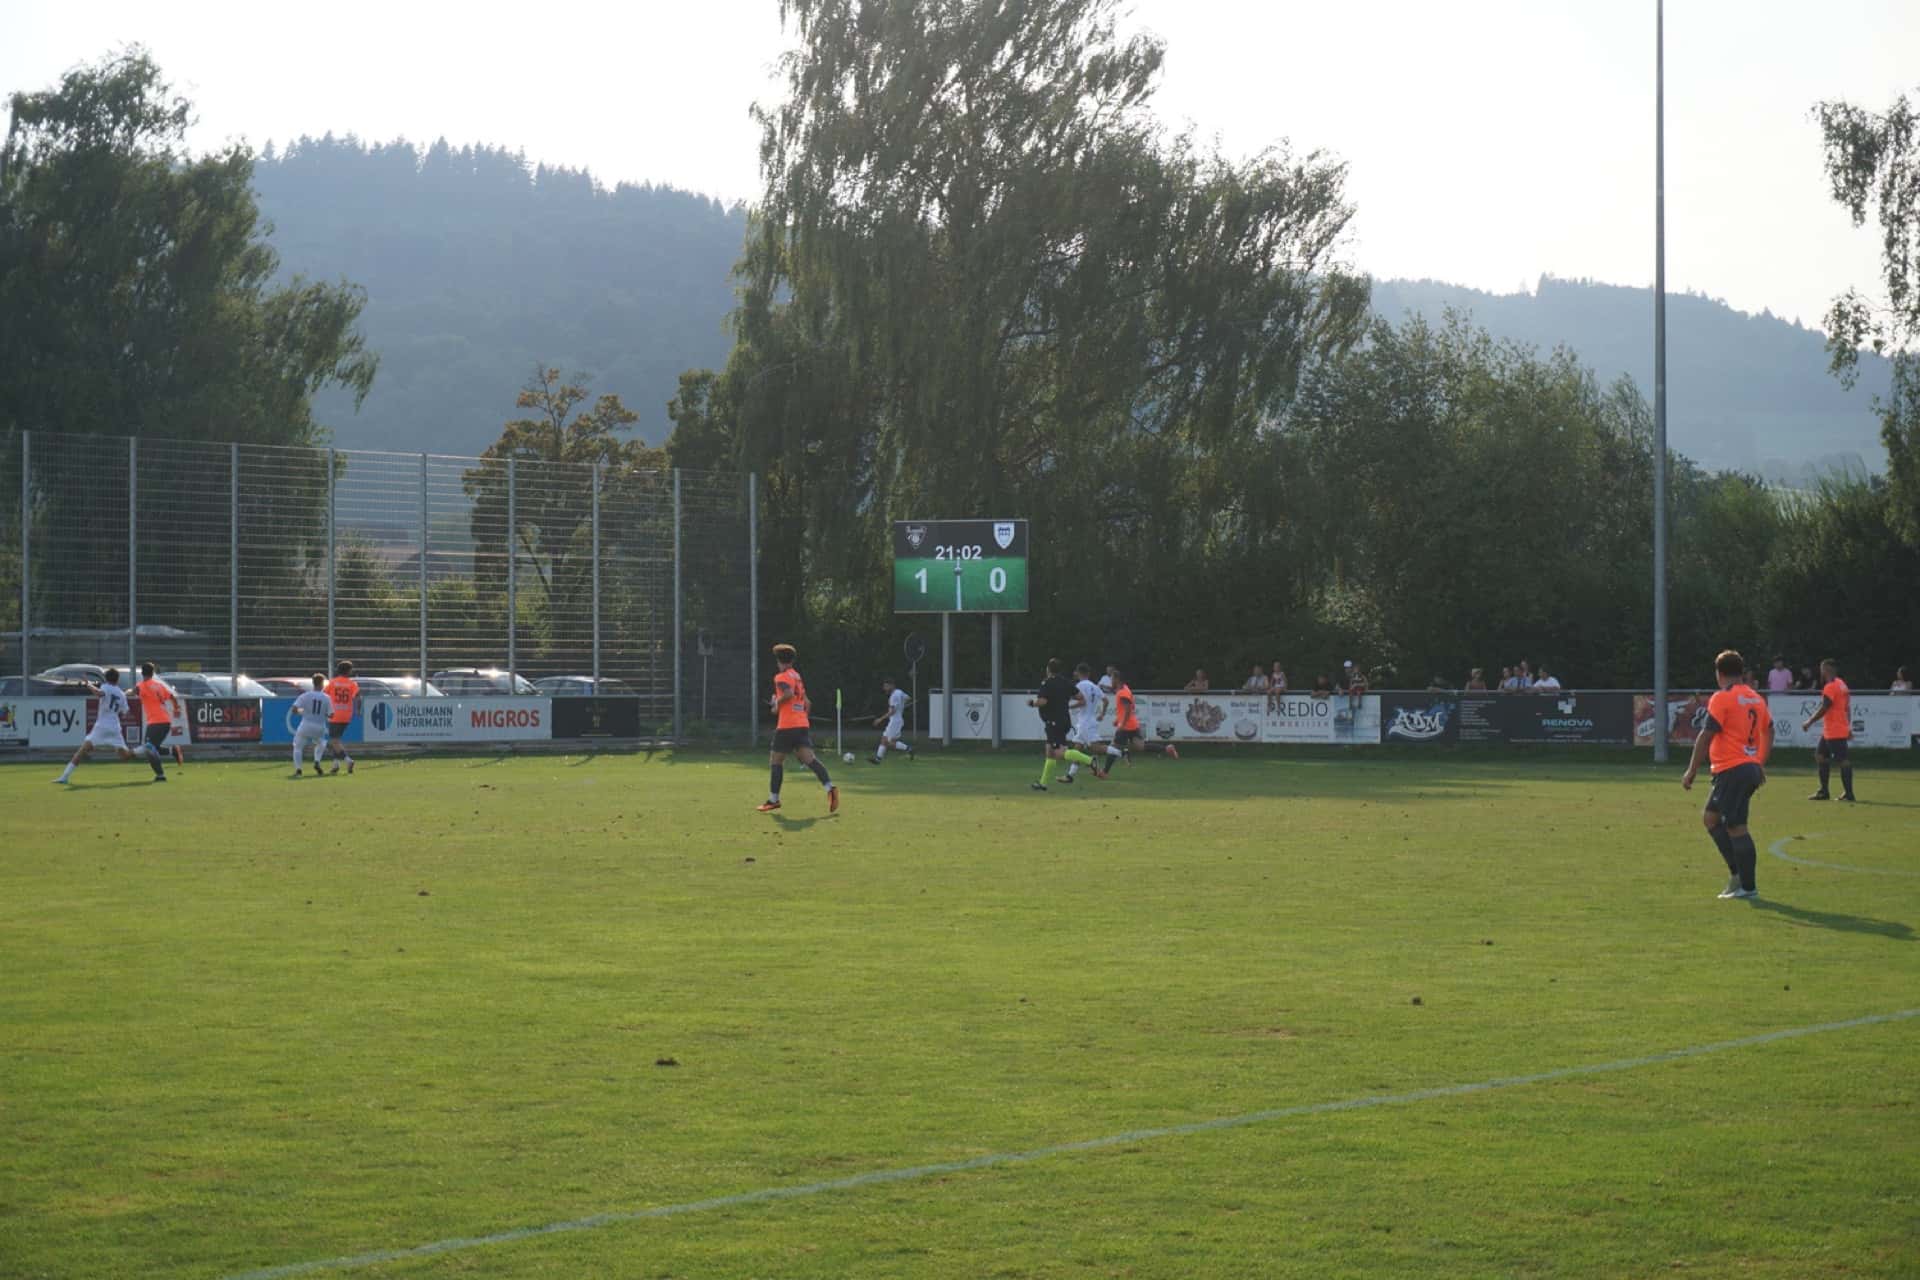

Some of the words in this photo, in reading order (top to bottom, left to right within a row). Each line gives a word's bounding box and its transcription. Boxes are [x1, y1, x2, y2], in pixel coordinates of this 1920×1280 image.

[935, 545, 982, 560] 21:02
[915, 567, 928, 594] 1
[989, 566, 1007, 594] 0
[312, 699, 322, 715] 11
[396, 704, 453, 717] HÜRLIMANN
[1266, 701, 1329, 717] PREDIO
[33, 708, 80, 732] nay.
[396, 717, 453, 728] INFORMATIK
[471, 710, 540, 728] MIGROS
[1541, 718, 1593, 727] RENOVA
